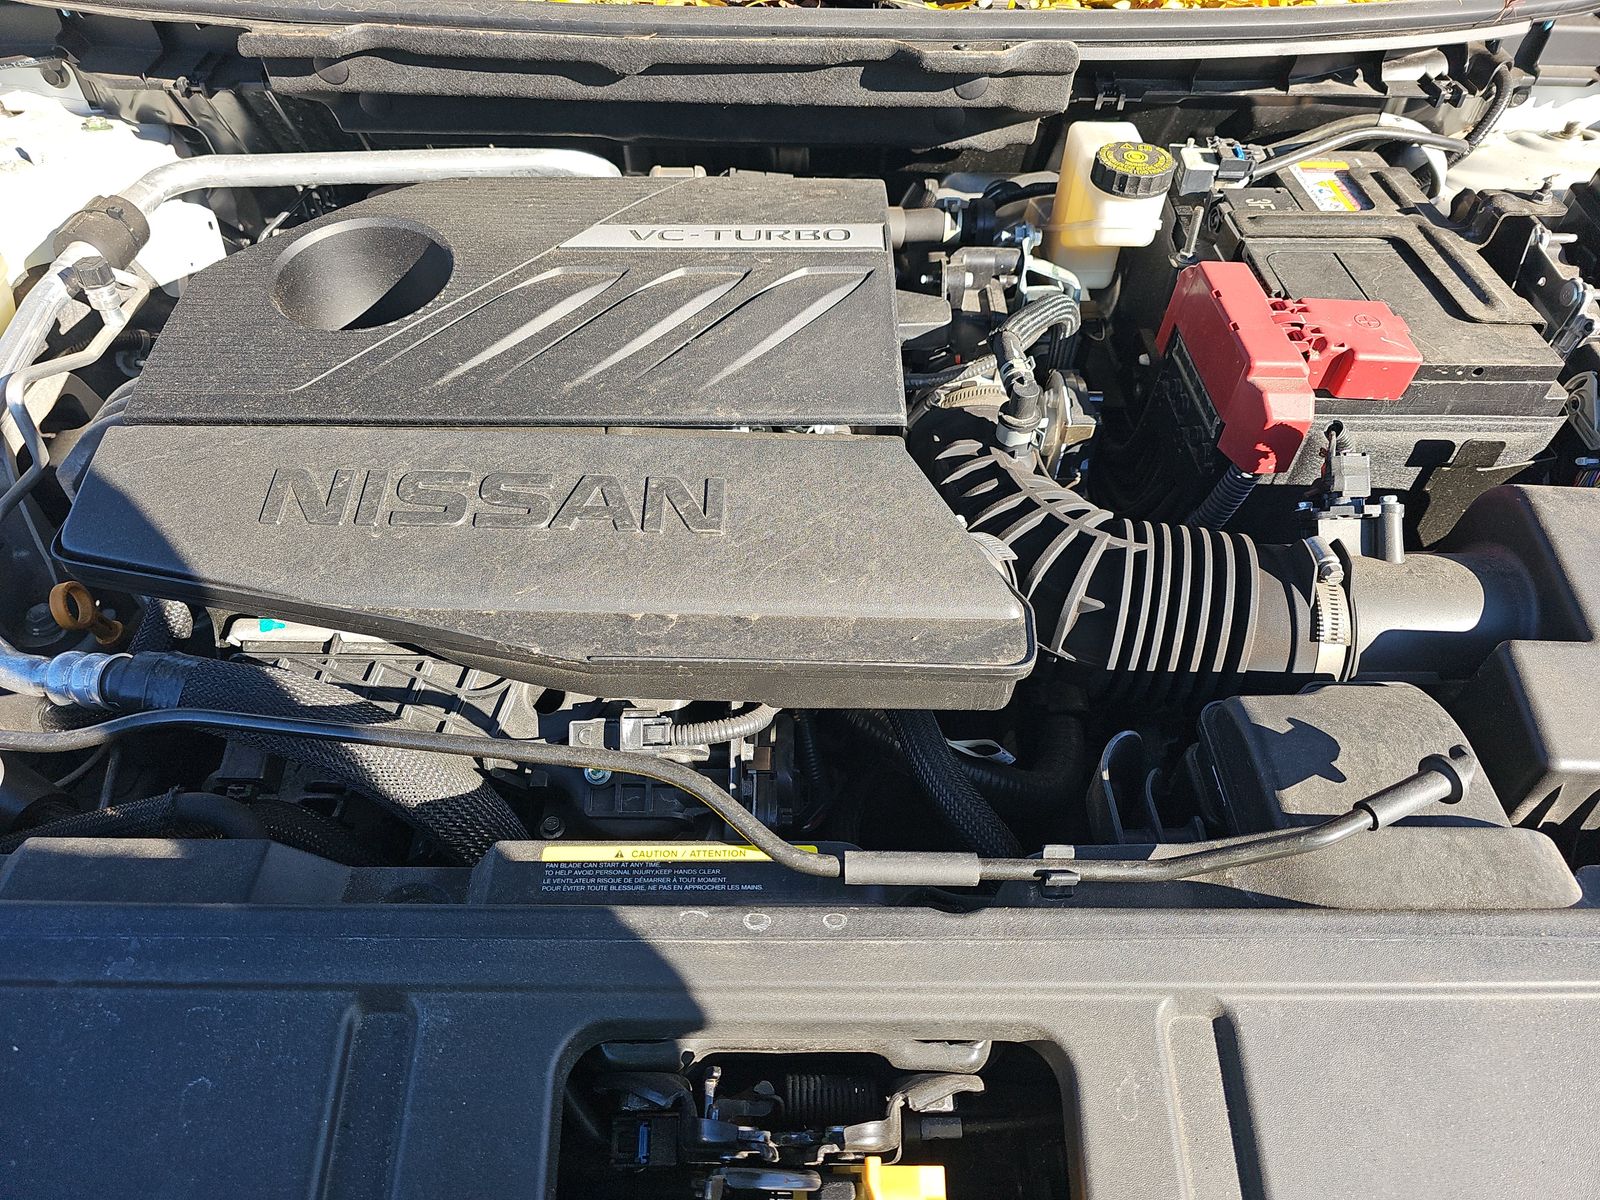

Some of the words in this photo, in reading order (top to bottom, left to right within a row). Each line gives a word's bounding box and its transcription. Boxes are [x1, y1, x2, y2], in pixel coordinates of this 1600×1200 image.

[628, 228, 851, 242] VC-TURBO
[258, 467, 727, 535] NISSAN
[631, 850, 678, 858] CAUTION
[689, 849, 746, 857] ATTENTION
[634, 876, 671, 884] DÉMARRER
[672, 875, 678, 883] À
[562, 884, 586, 892] ÉVITER
